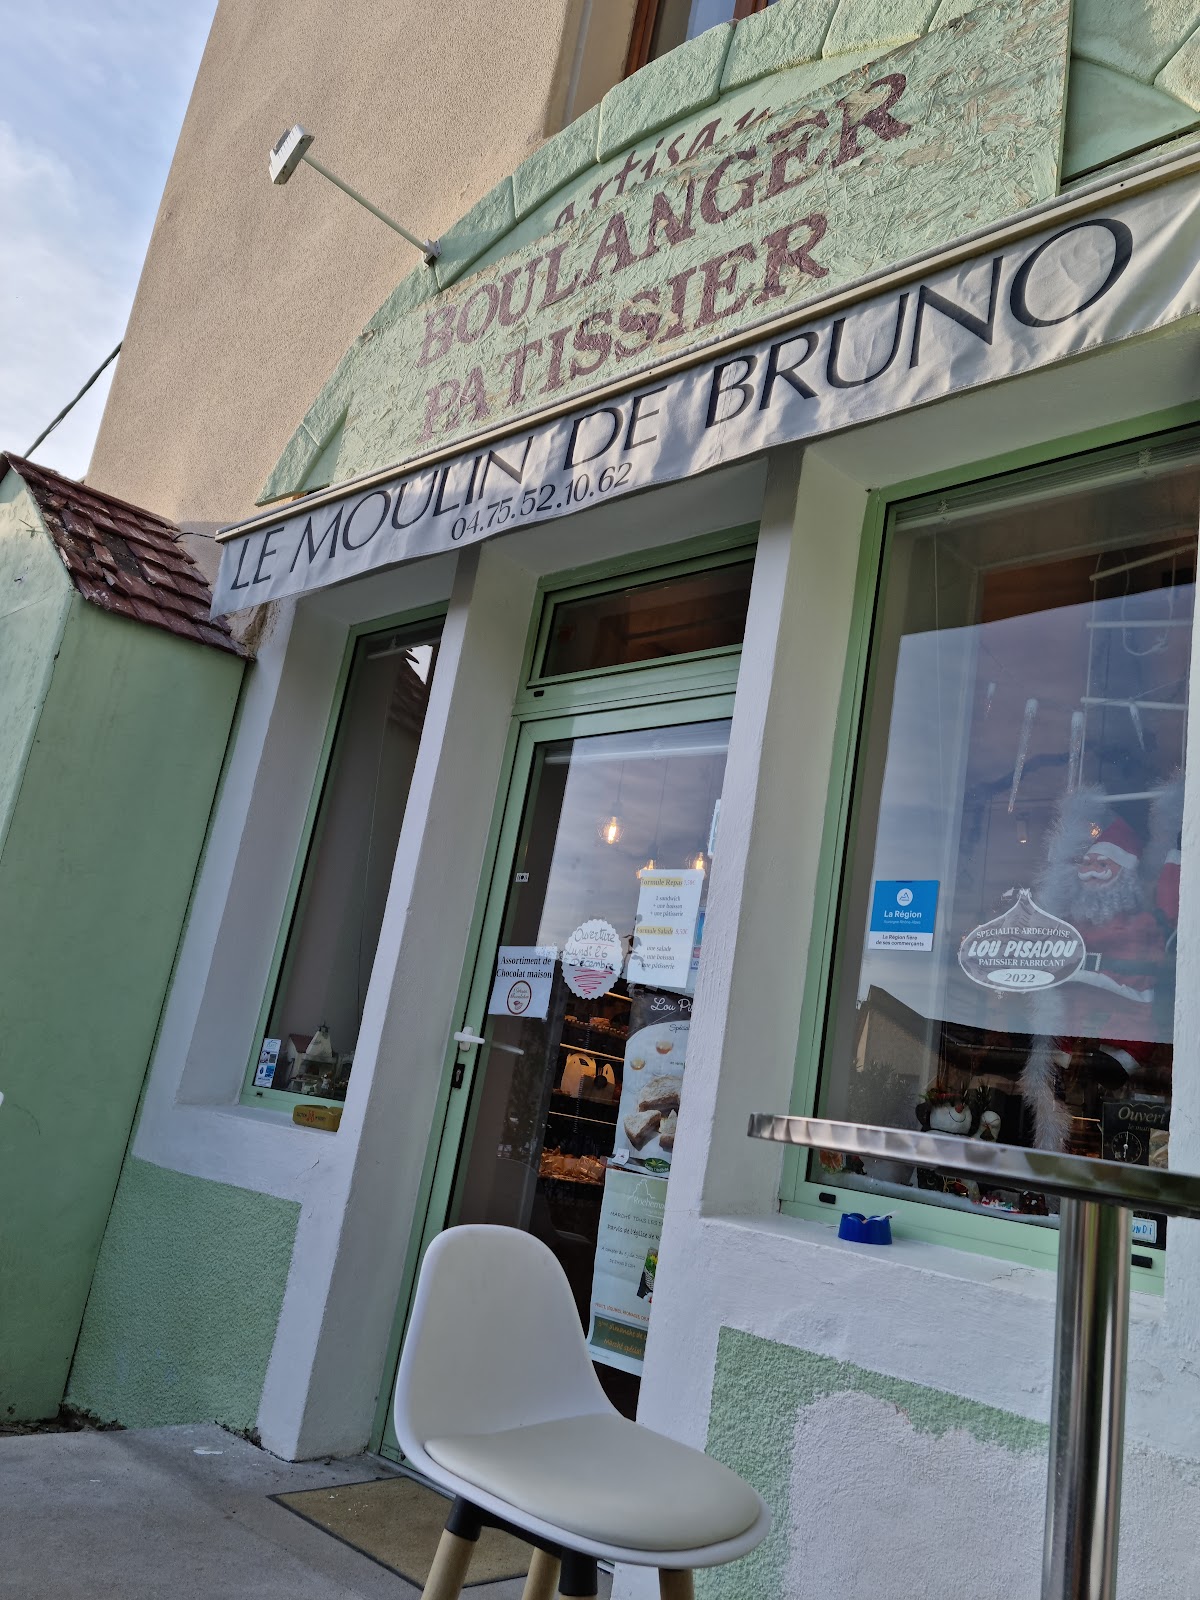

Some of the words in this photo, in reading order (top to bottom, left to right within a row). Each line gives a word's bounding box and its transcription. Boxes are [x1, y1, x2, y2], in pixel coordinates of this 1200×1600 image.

[416, 72, 912, 369] BOULANGER
[416, 212, 831, 444] PATISSIER
[229, 526, 285, 590] LE
[289, 435, 535, 574] MOULIN
[563, 385, 669, 471] DE
[705, 218, 1133, 429] BRUNO
[451, 462, 633, 541] 04.75.52.10.62
[884, 910, 893, 918] La
[894, 910, 922, 920] Région
[574, 928, 616, 943] Ouverture
[1021, 927, 1071, 939] ARDECHOISE
[594, 945, 608, 959] 26
[967, 940, 1002, 957] LOU
[1003, 940, 1079, 959] PISADOU
[500, 956, 541, 965] Assortiment
[542, 956, 552, 966] de
[978, 958, 1018, 967] PATISSIER
[1020, 958, 1066, 968] FABRICANT
[496, 968, 526, 978] Chocolat
[527, 969, 552, 979] maison
[1004, 972, 1036, 983] 2022
[650, 997, 676, 1011] Lou
[1118, 1106, 1166, 1124] Ouvert
[633, 1196, 665, 1209] Rochema
